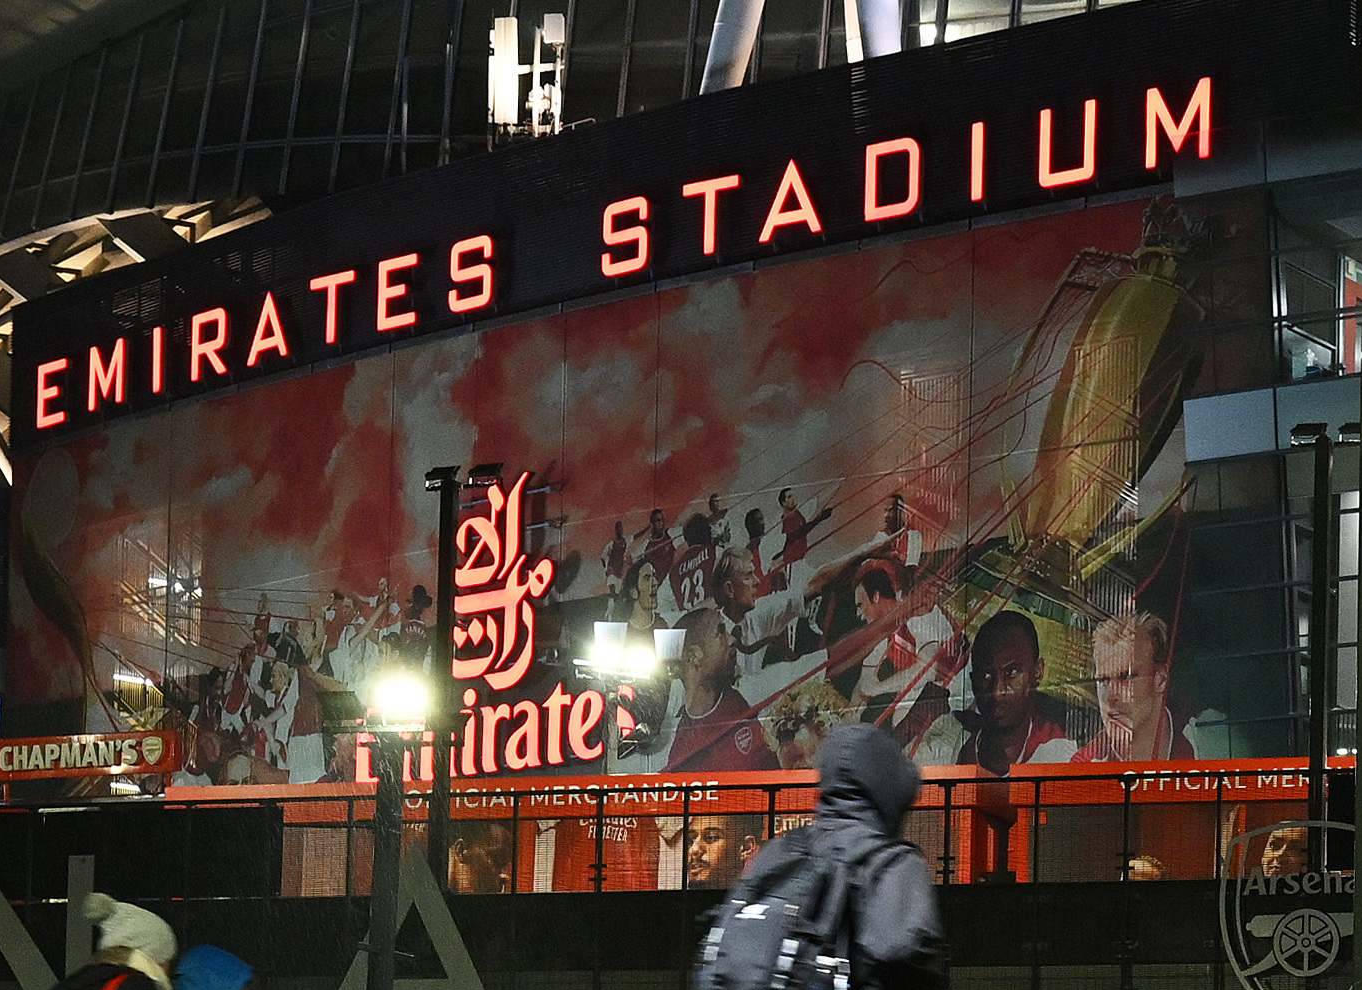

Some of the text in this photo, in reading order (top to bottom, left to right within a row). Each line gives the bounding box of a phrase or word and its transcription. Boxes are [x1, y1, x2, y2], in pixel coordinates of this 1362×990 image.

[35, 76, 1215, 429] EMIRATES STADIUM
[680, 568, 705, 610] 23
[405, 781, 719, 808] OICIAL MERCHANDISE
[1121, 769, 1247, 792] OFFICIAL
[1243, 866, 1356, 896] Arsena
